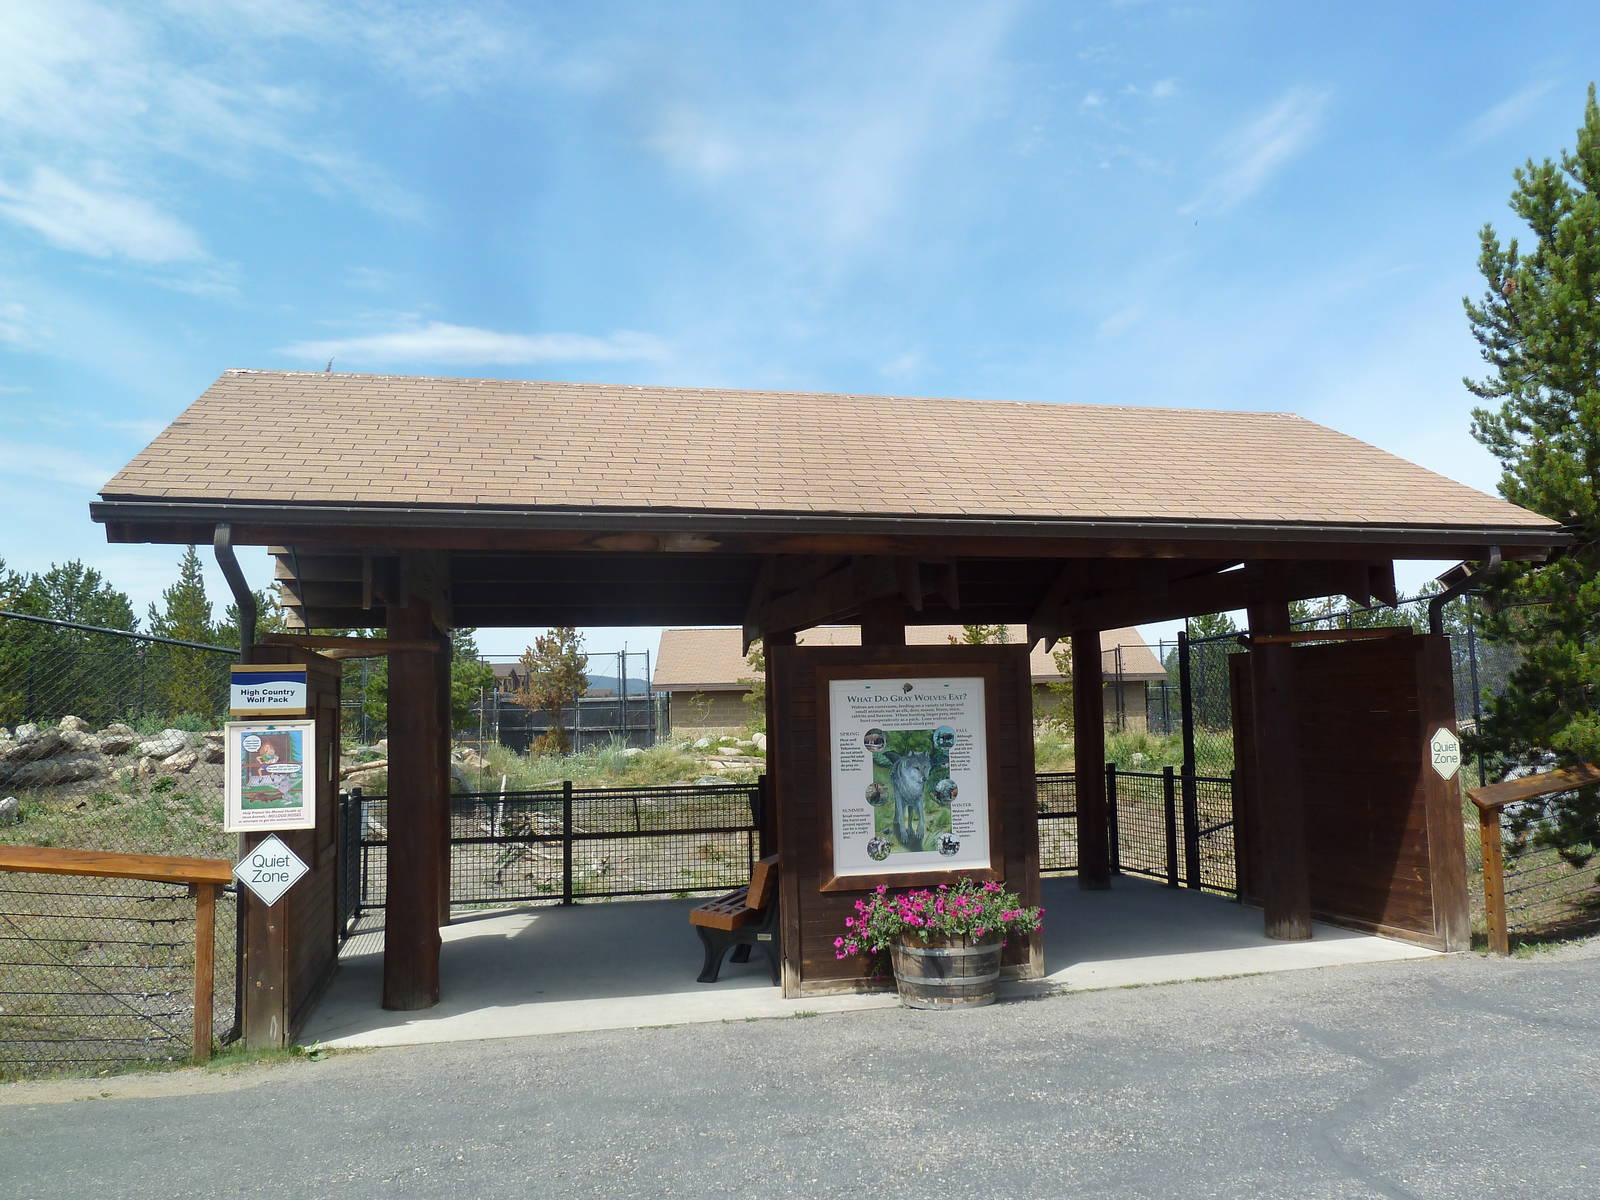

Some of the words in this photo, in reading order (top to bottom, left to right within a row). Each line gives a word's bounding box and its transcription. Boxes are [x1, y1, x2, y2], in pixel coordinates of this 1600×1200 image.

[1433, 742, 1457, 752] Quiet
[1434, 754, 1457, 763] Zone
[252, 854, 290, 868] Quiet
[252, 870, 289, 882] Zone
